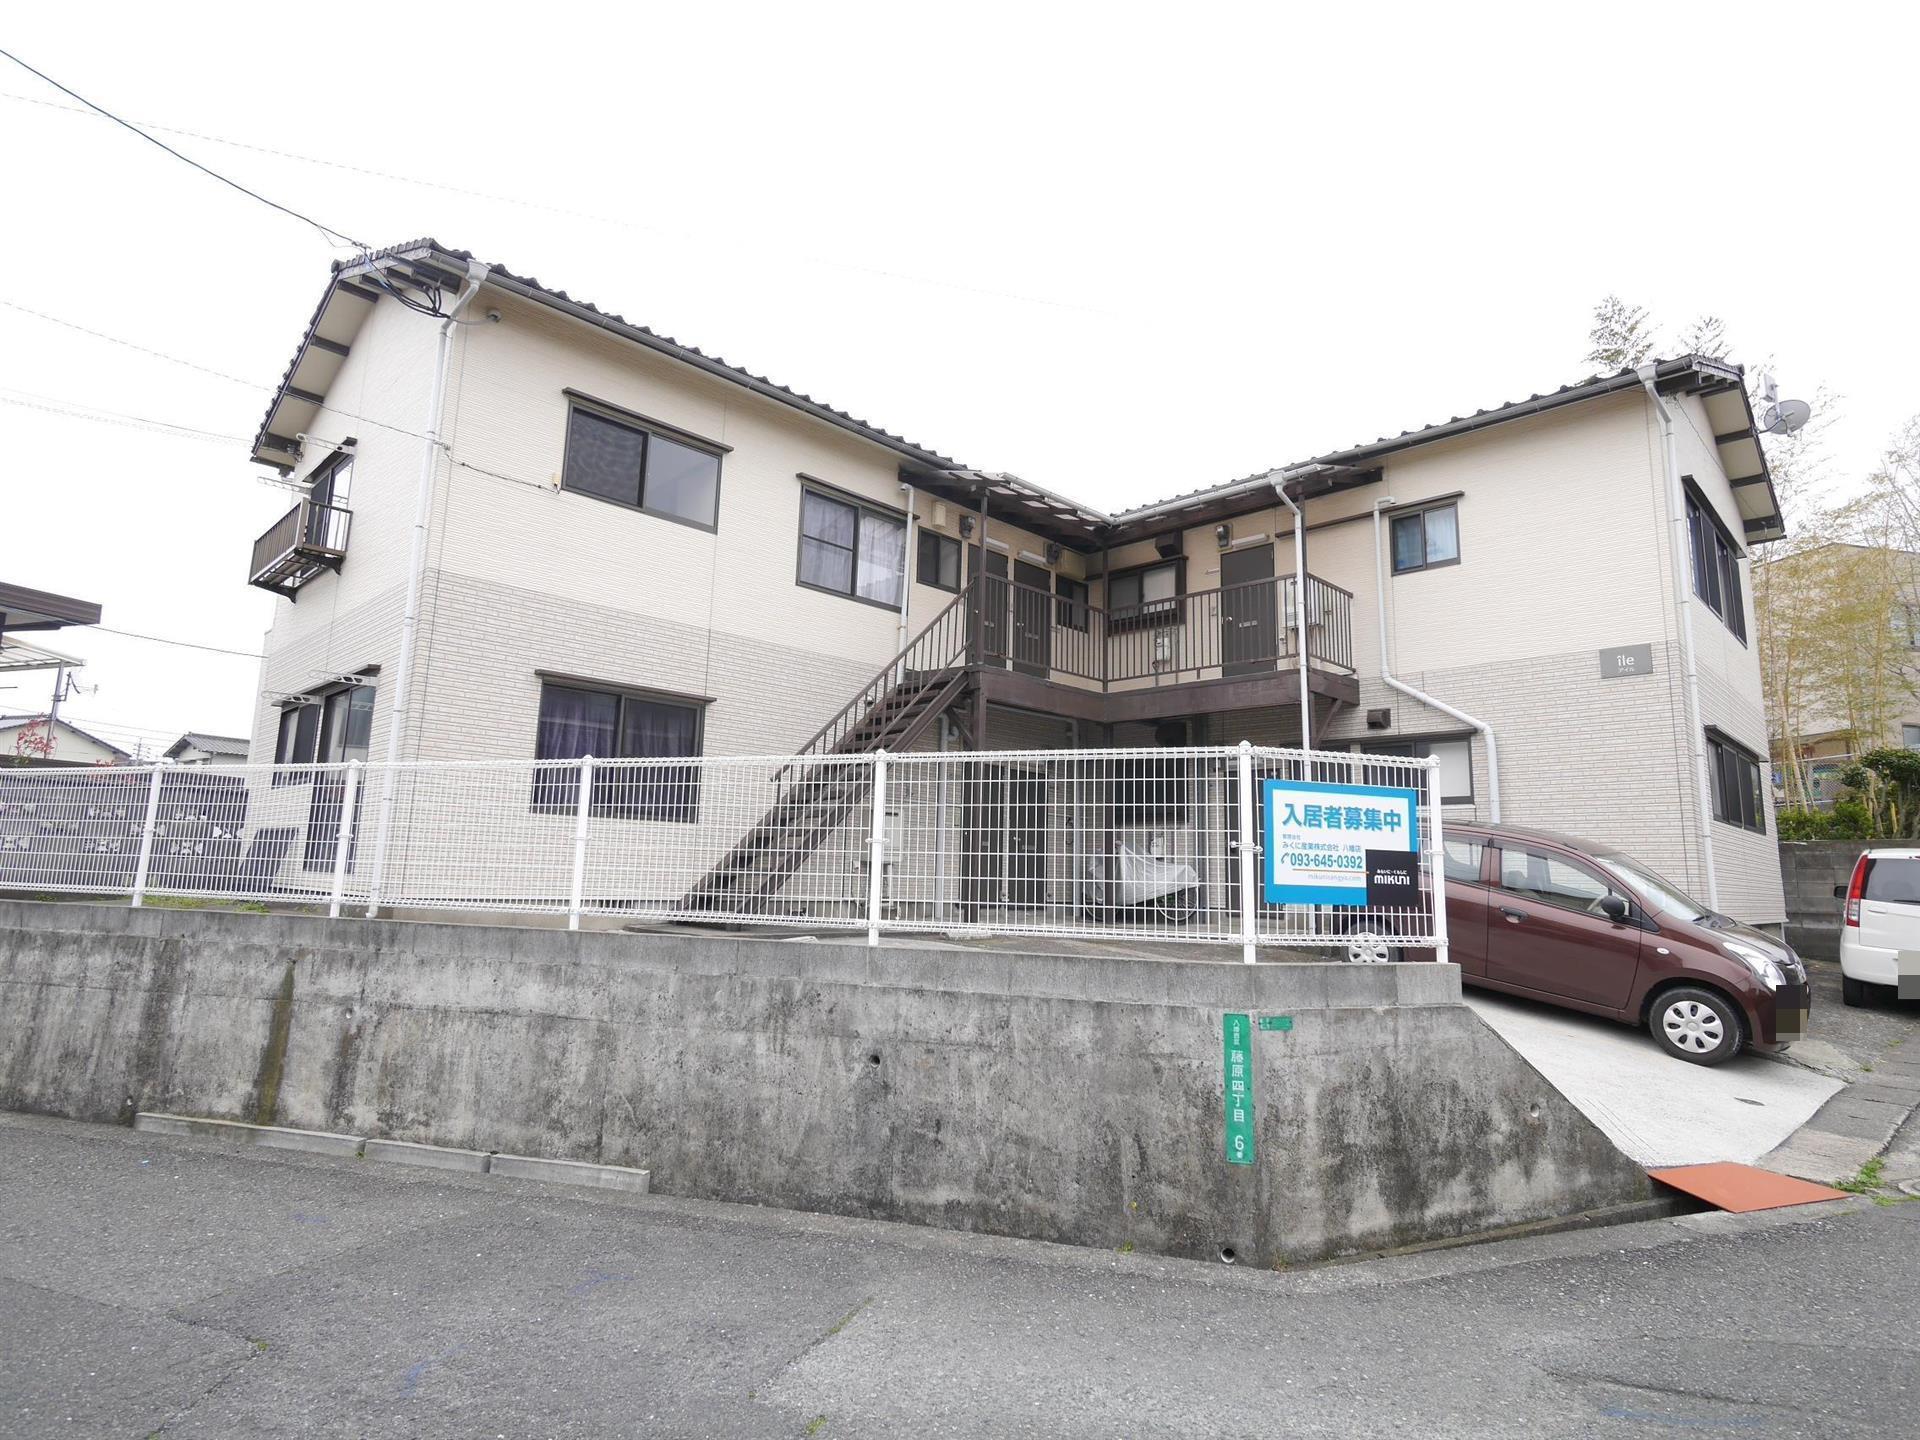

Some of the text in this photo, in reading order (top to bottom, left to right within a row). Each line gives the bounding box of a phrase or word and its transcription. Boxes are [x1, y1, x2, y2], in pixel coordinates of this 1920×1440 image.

[1282, 803, 1402, 832] 入居者募集中
[1282, 841, 1340, 852] みくに産業株式会社
[1230, 1049, 1245, 1123] 藤原四丁目
